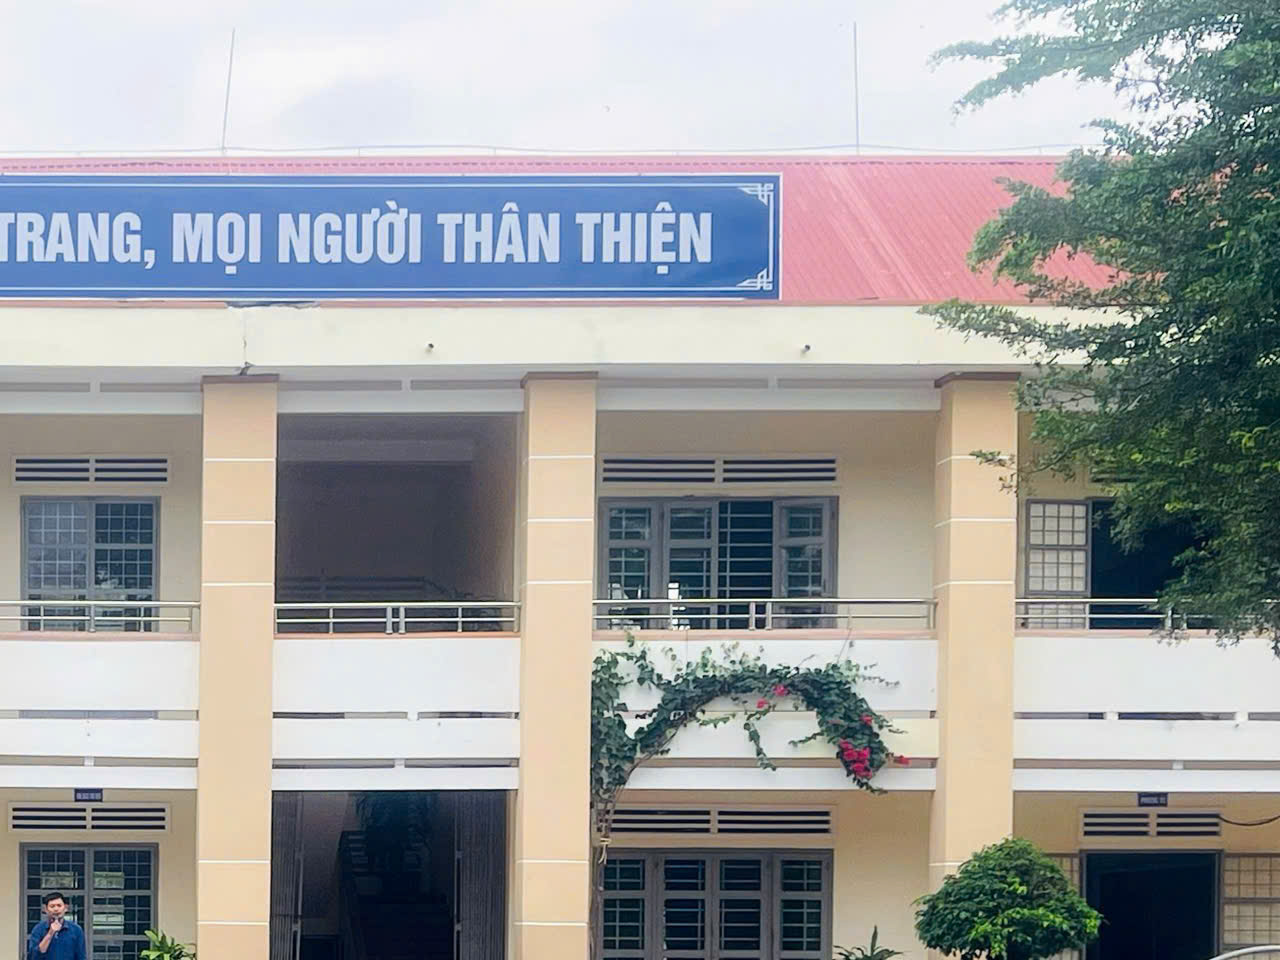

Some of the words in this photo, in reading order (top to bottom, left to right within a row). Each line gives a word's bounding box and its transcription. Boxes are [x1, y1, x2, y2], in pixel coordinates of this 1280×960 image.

[171, 212, 263, 276] MỌI
[277, 200, 422, 265] NGƯỜI
[436, 201, 561, 265] THÂN
[575, 201, 712, 276] THIỆN
